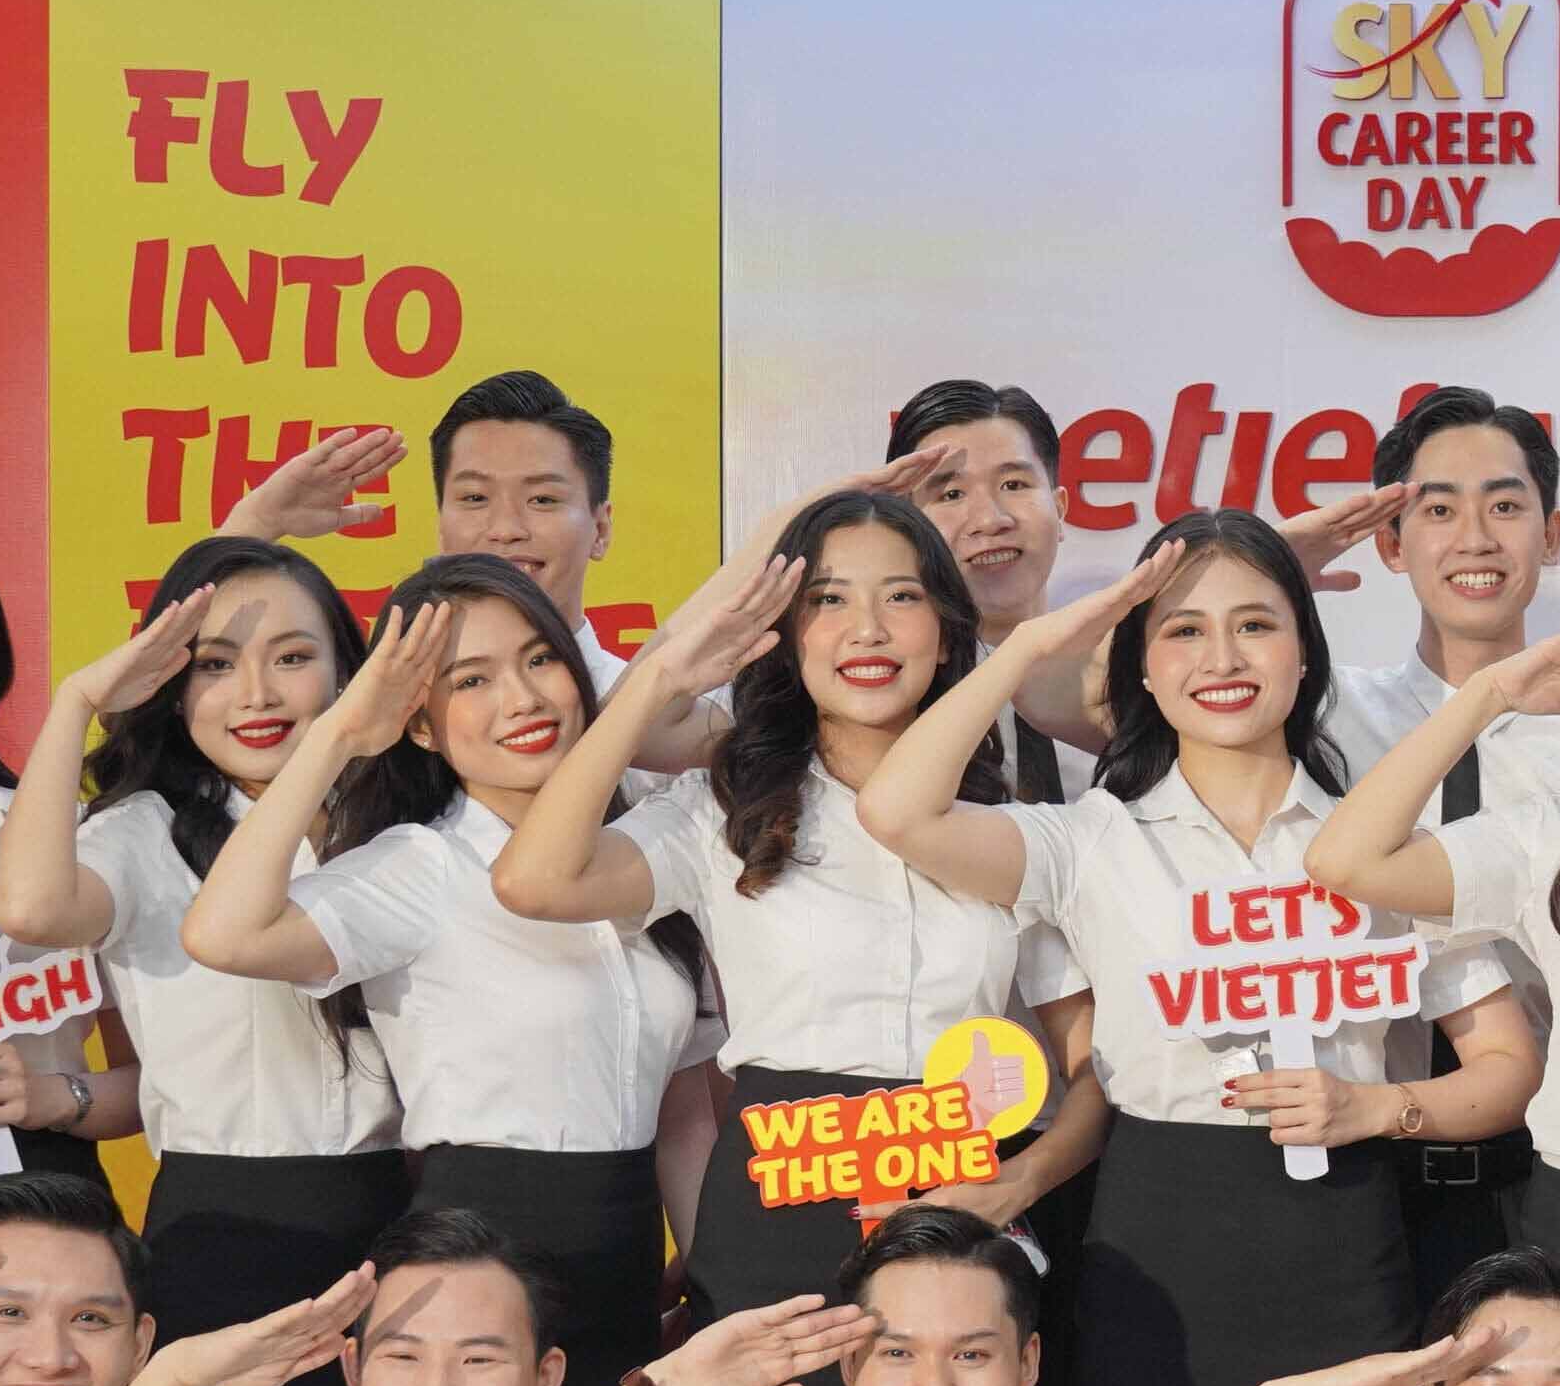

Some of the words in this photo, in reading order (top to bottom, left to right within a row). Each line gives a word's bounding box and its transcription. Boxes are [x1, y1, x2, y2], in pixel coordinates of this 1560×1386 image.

[1332, 2, 1531, 101] SKY
[124, 68, 383, 206] FLY
[1317, 111, 1536, 166] CAREER
[1367, 177, 1488, 232] DAY
[128, 238, 463, 378] INTO
[1148, 945, 1417, 1027] VIETJET
[744, 1101, 844, 1151] WE
[856, 1087, 968, 1141] ARE
[753, 1151, 861, 1202] THE
[875, 1136, 993, 1189] ONE
